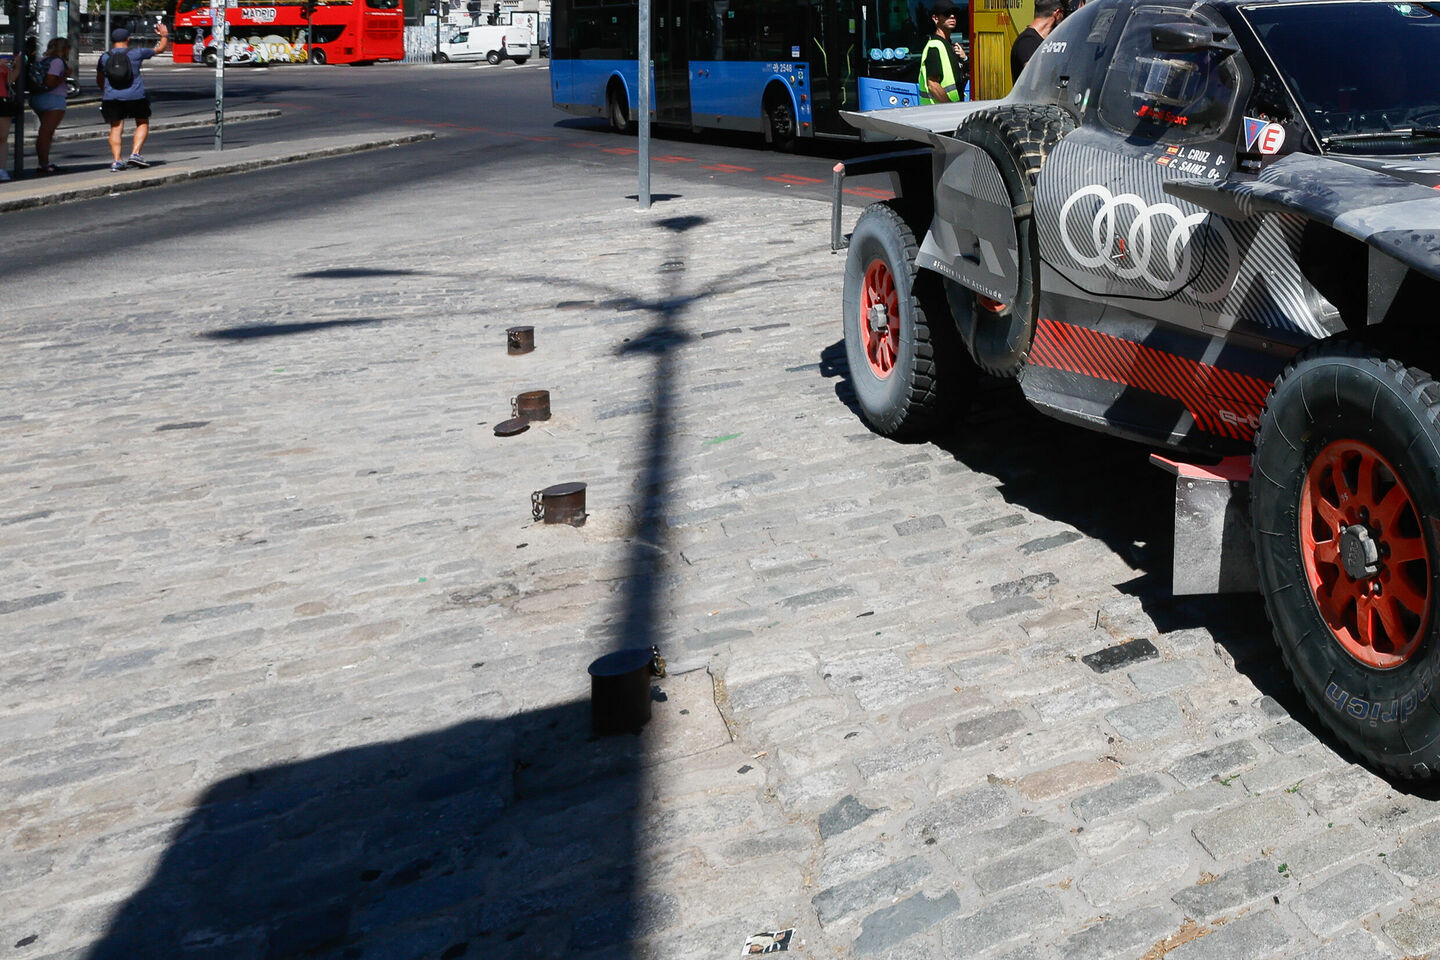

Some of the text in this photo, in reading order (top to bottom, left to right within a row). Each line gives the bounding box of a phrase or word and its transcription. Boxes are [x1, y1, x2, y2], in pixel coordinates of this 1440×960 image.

[242, 8, 276, 19] MADRID
[1263, 129, 1280, 151] E
[1178, 146, 1185, 158] L.
[1187, 149, 1210, 163] CRUZ
[1168, 159, 1177, 169] C.
[1179, 162, 1206, 176] SAINZ
[933, 260, 954, 276] #Future
[972, 280, 1002, 298] Attitude
